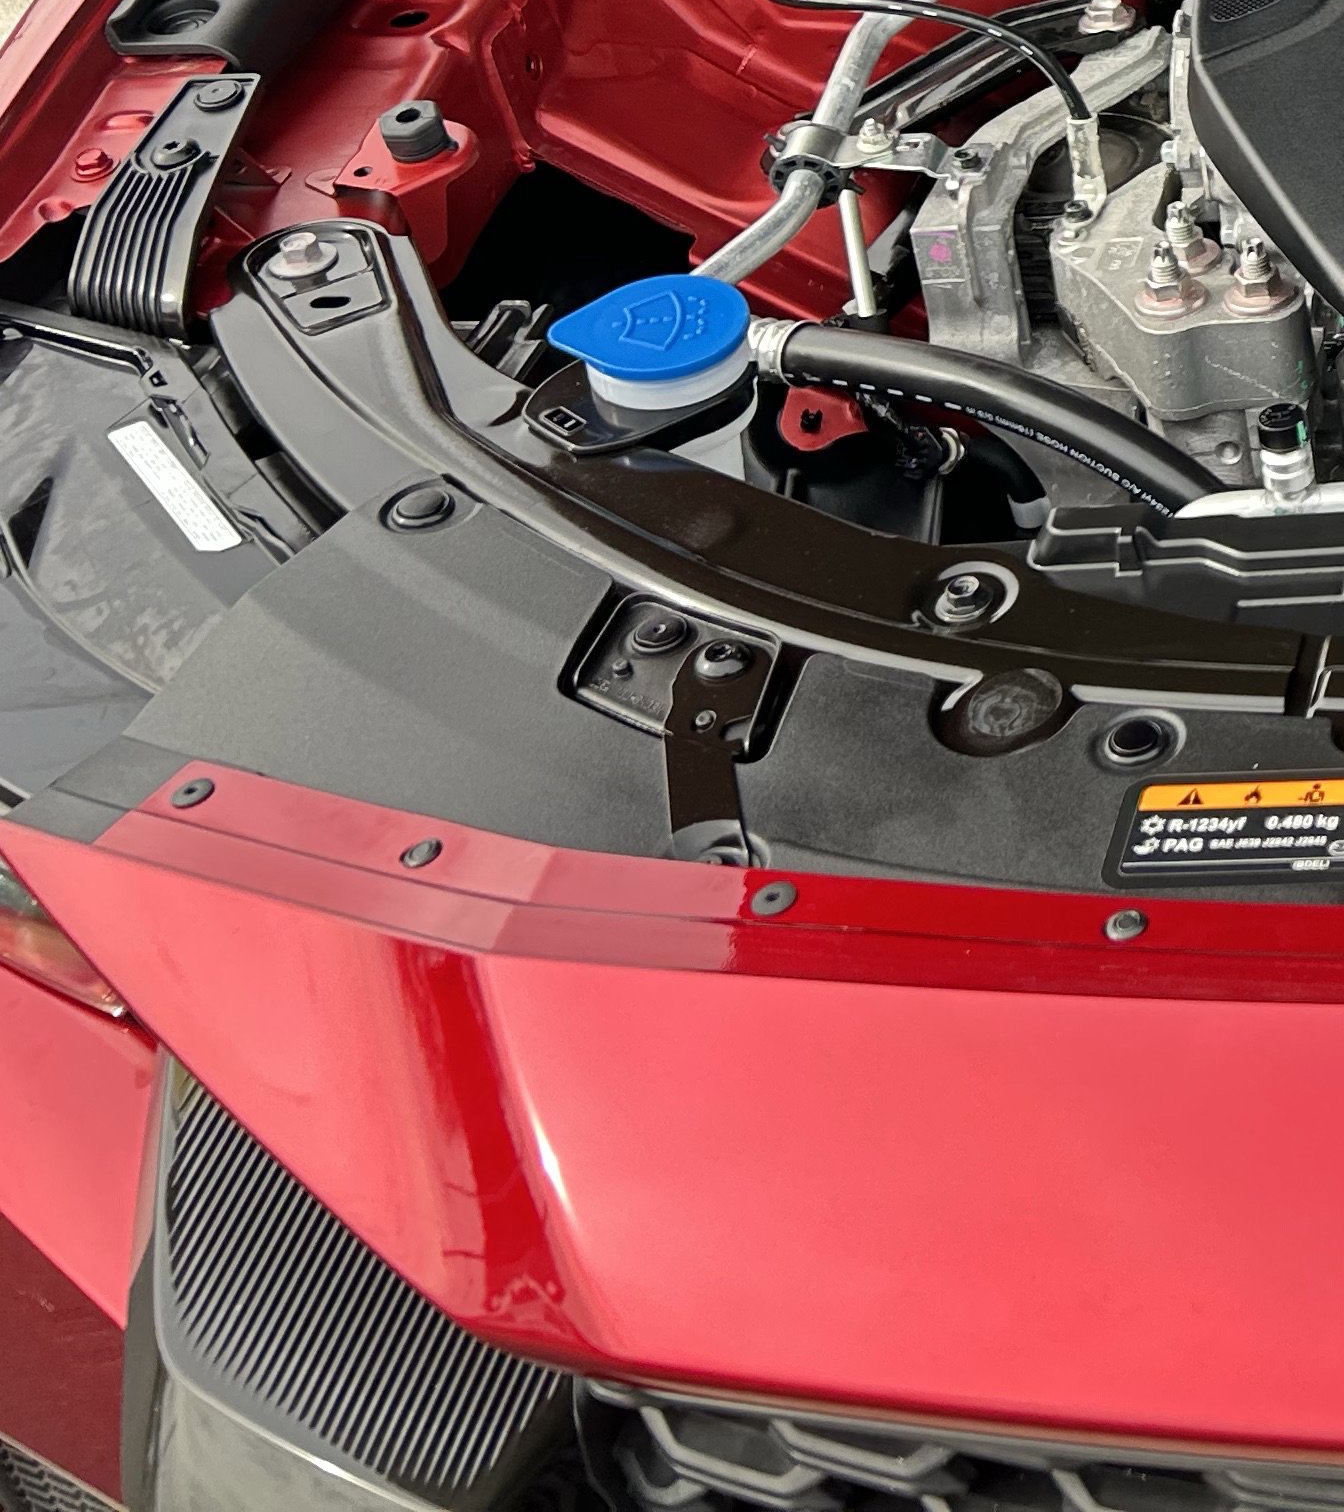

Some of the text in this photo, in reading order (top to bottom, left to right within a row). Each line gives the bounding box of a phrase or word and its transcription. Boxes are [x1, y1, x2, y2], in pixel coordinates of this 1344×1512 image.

[1035, 431, 1069, 453] HOSE
[1069, 448, 1120, 482] SUCTION
[1166, 813, 1340, 835] R-1234yf 0.480 kg
[1161, 837, 1204, 853] PAG
